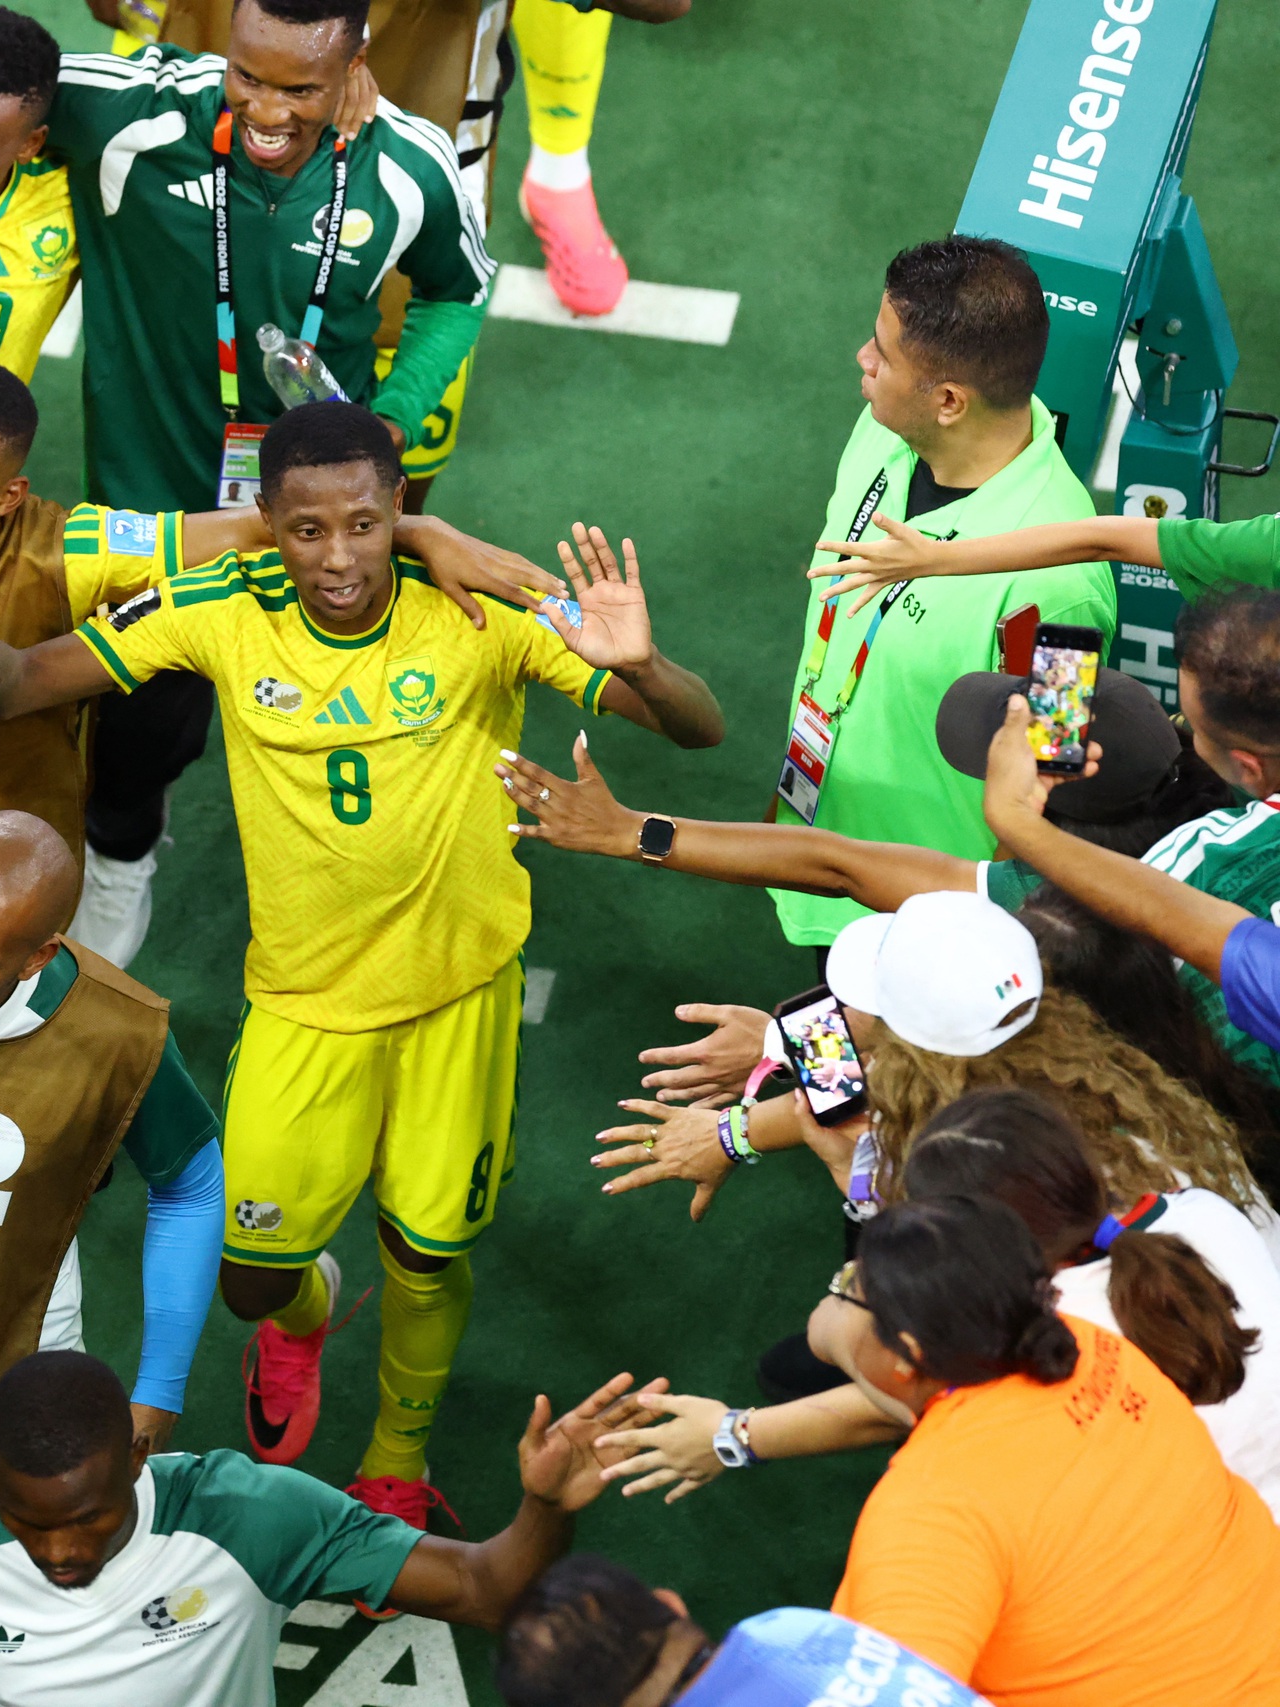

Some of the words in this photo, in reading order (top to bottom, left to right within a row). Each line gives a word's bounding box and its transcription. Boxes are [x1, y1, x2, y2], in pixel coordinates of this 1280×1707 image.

[1018, 0, 1154, 229] Hisense
[215, 165, 226, 206] 2026
[336, 161, 346, 189] FIFA
[216, 206, 226, 229] CUP
[329, 189, 345, 234] WORLD
[217, 231, 229, 269] WORLD
[325, 233, 338, 255] CUP
[219, 270, 229, 292] FIFA
[314, 256, 332, 295] 2026
[854, 491, 880, 531] WORLD
[875, 472, 888, 492] CU
[1121, 562, 1159, 576] WORLD
[903, 593, 926, 624] 631
[242, 707, 266, 718] FOOTBALL
[268, 715, 300, 729] ASSOCIATION
[401, 718, 422, 726] SOUTH
[422, 710, 441, 724] AFRICA
[326, 748, 372, 825] 8
[465, 1141, 494, 1223] 8
[142, 1636, 176, 1647] FOOTBALL
[154, 1628, 178, 1638] SOUTH
[178, 1621, 207, 1632] AFRICAN
